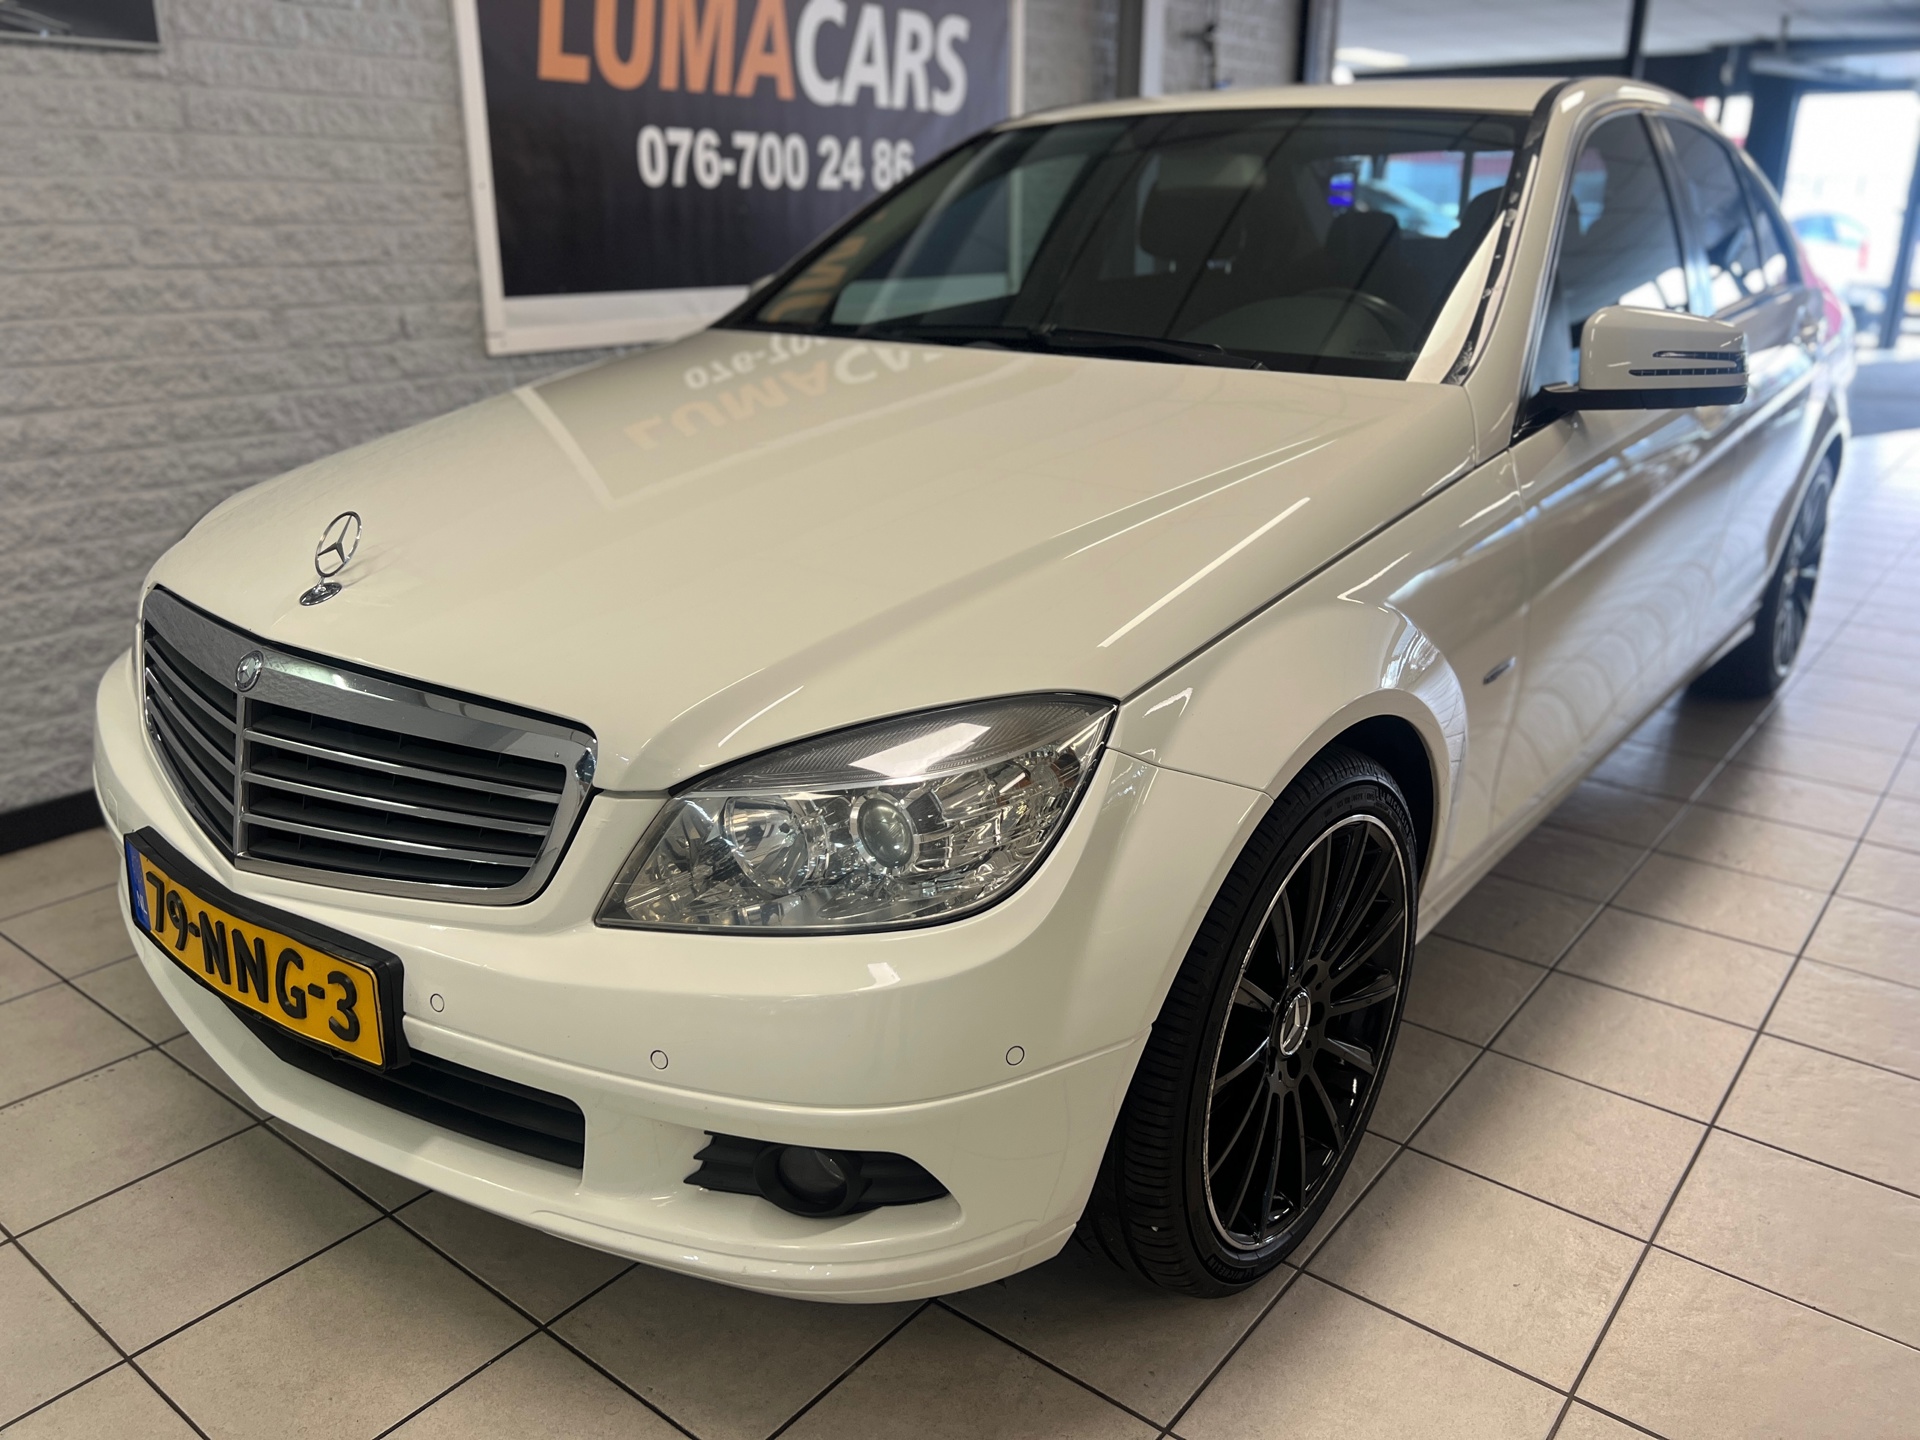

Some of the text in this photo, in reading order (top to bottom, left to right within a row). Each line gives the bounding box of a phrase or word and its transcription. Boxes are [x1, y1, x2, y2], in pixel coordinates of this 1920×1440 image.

[636, 125, 914, 192] 076-700 24 86
[1386, 793, 1411, 834] MICHELIN
[136, 890, 148, 916] NL
[146, 871, 361, 1043] 79-NNG-3
